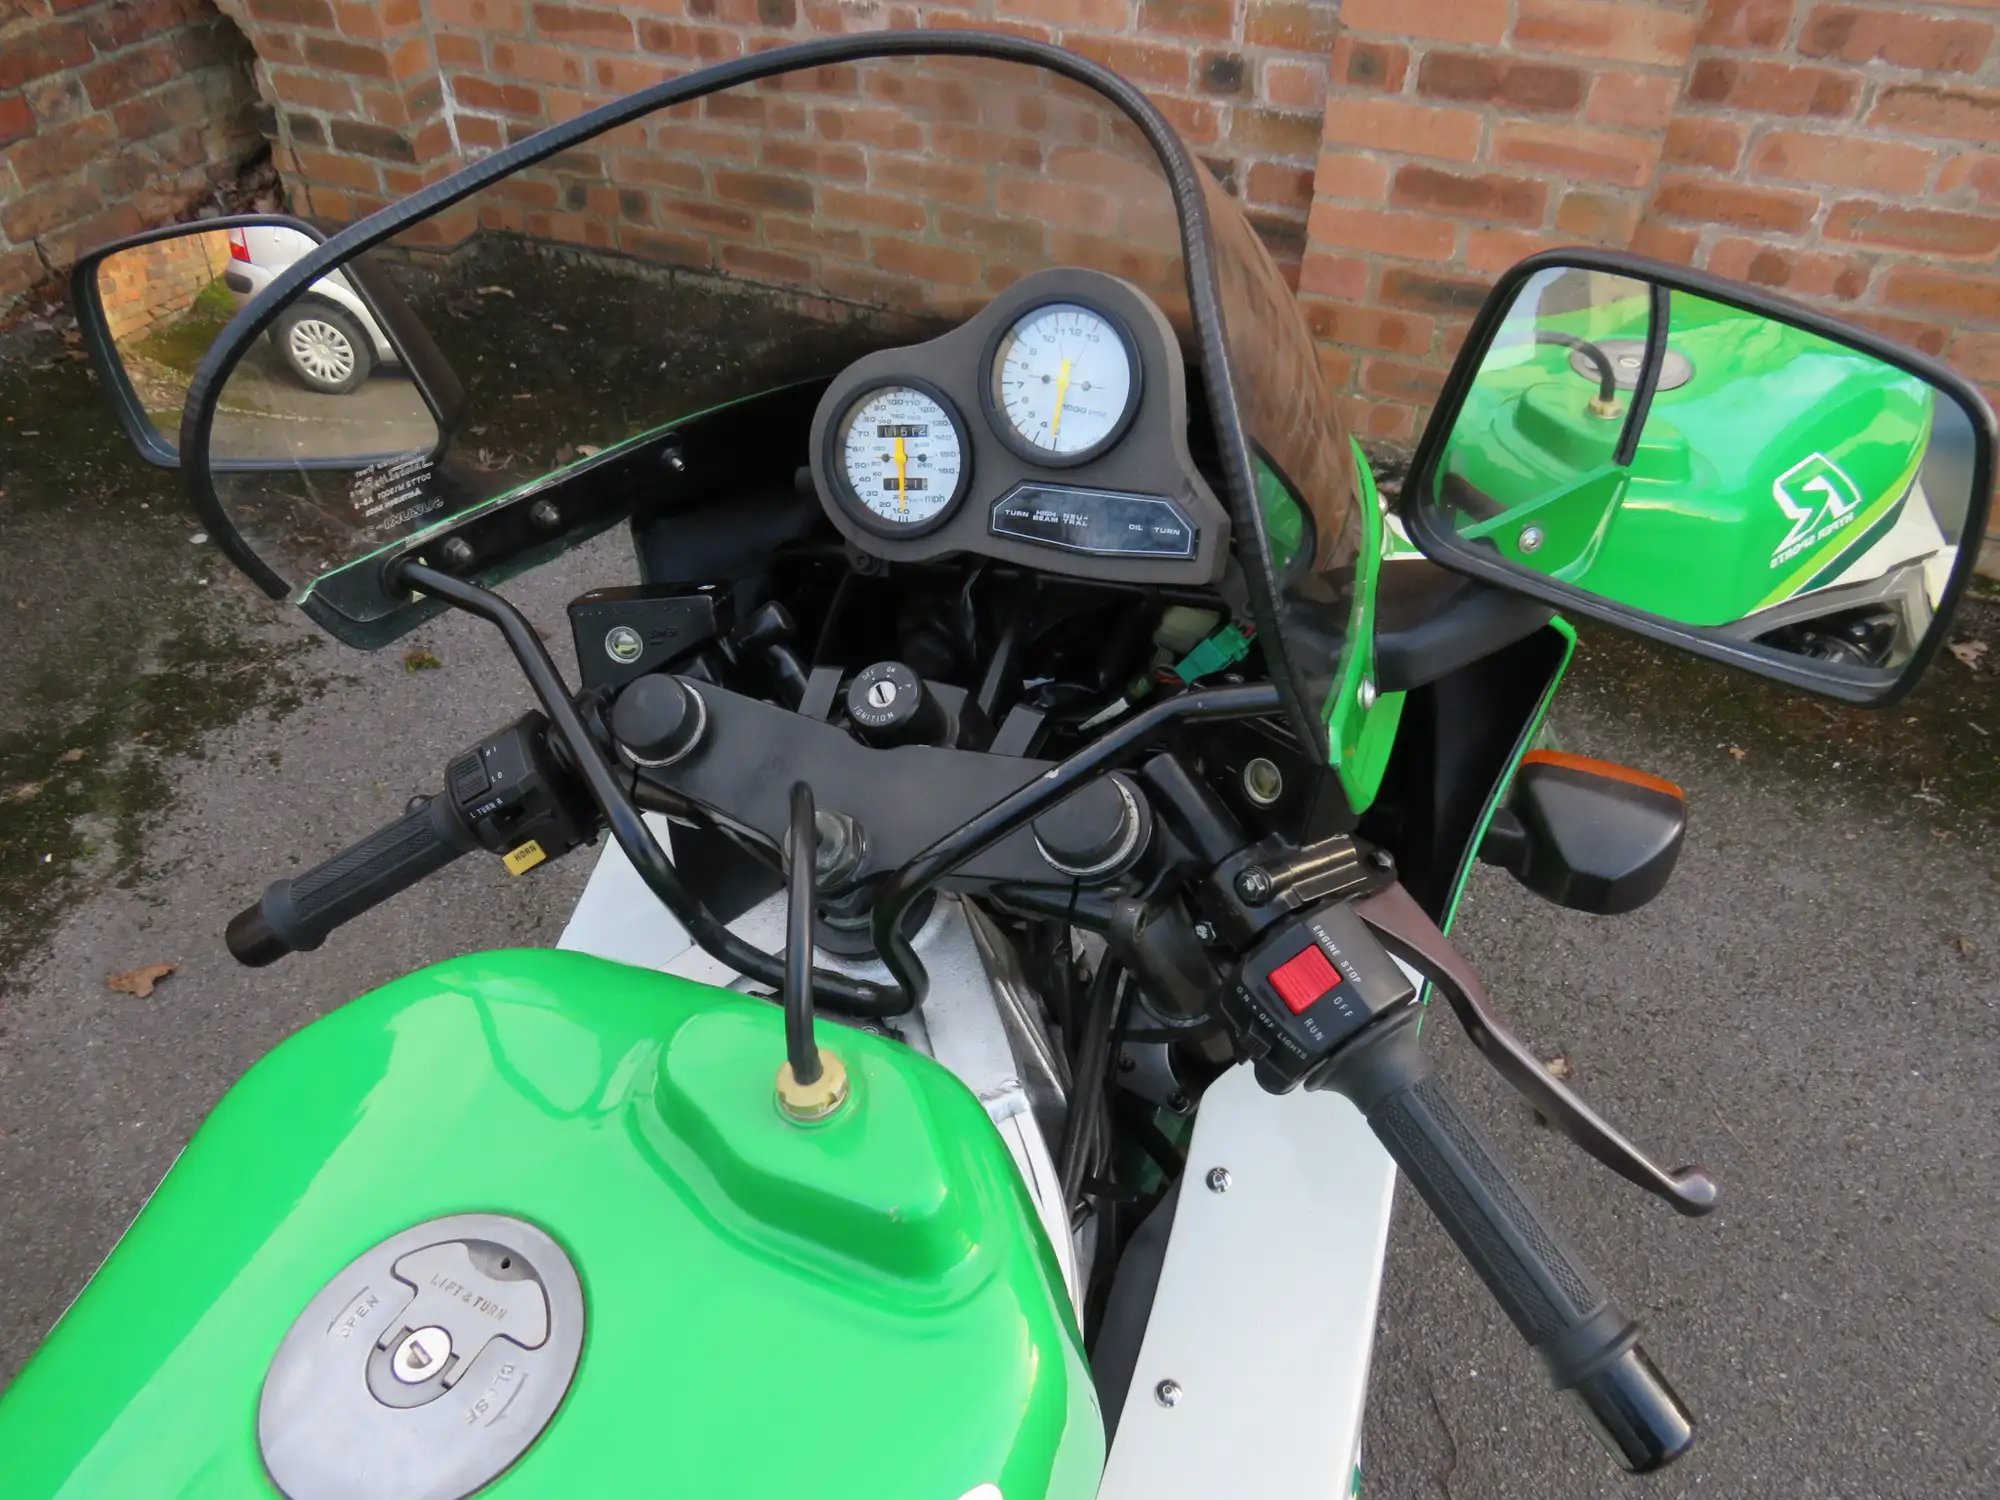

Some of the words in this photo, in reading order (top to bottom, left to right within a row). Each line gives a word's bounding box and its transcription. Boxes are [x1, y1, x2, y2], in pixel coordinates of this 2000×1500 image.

[1068, 328, 1082, 336] 12
[1042, 335, 1055, 343] 10
[1086, 334, 1100, 342] 13
[925, 494, 945, 504] mph
[1005, 509, 1029, 518] TURN
[1036, 509, 1057, 517] HIGH
[1032, 515, 1058, 523] BEAM
[1062, 519, 1088, 527] TRAL
[1154, 527, 1180, 536] TURN
[862, 669, 875, 680] OFF
[854, 705, 895, 722] IGNITION
[485, 746, 497, 757] HI
[491, 771, 503, 782] LO
[476, 801, 497, 816] TURN
[496, 797, 504, 805] R
[514, 844, 537, 862] HORN
[1312, 924, 1341, 957] ENGINE
[1340, 960, 1362, 984] STOP
[1332, 996, 1354, 1018] OFF
[1236, 986, 1250, 1002] ON
[1259, 1013, 1275, 1029] OFF
[1276, 1032, 1308, 1060] LIGHTS
[1304, 1018, 1325, 1041] RUN
[430, 1273, 463, 1296] LIFT
[462, 1292, 471, 1303] &
[472, 1295, 508, 1321] TURN
[341, 1294, 379, 1338] OPEN
